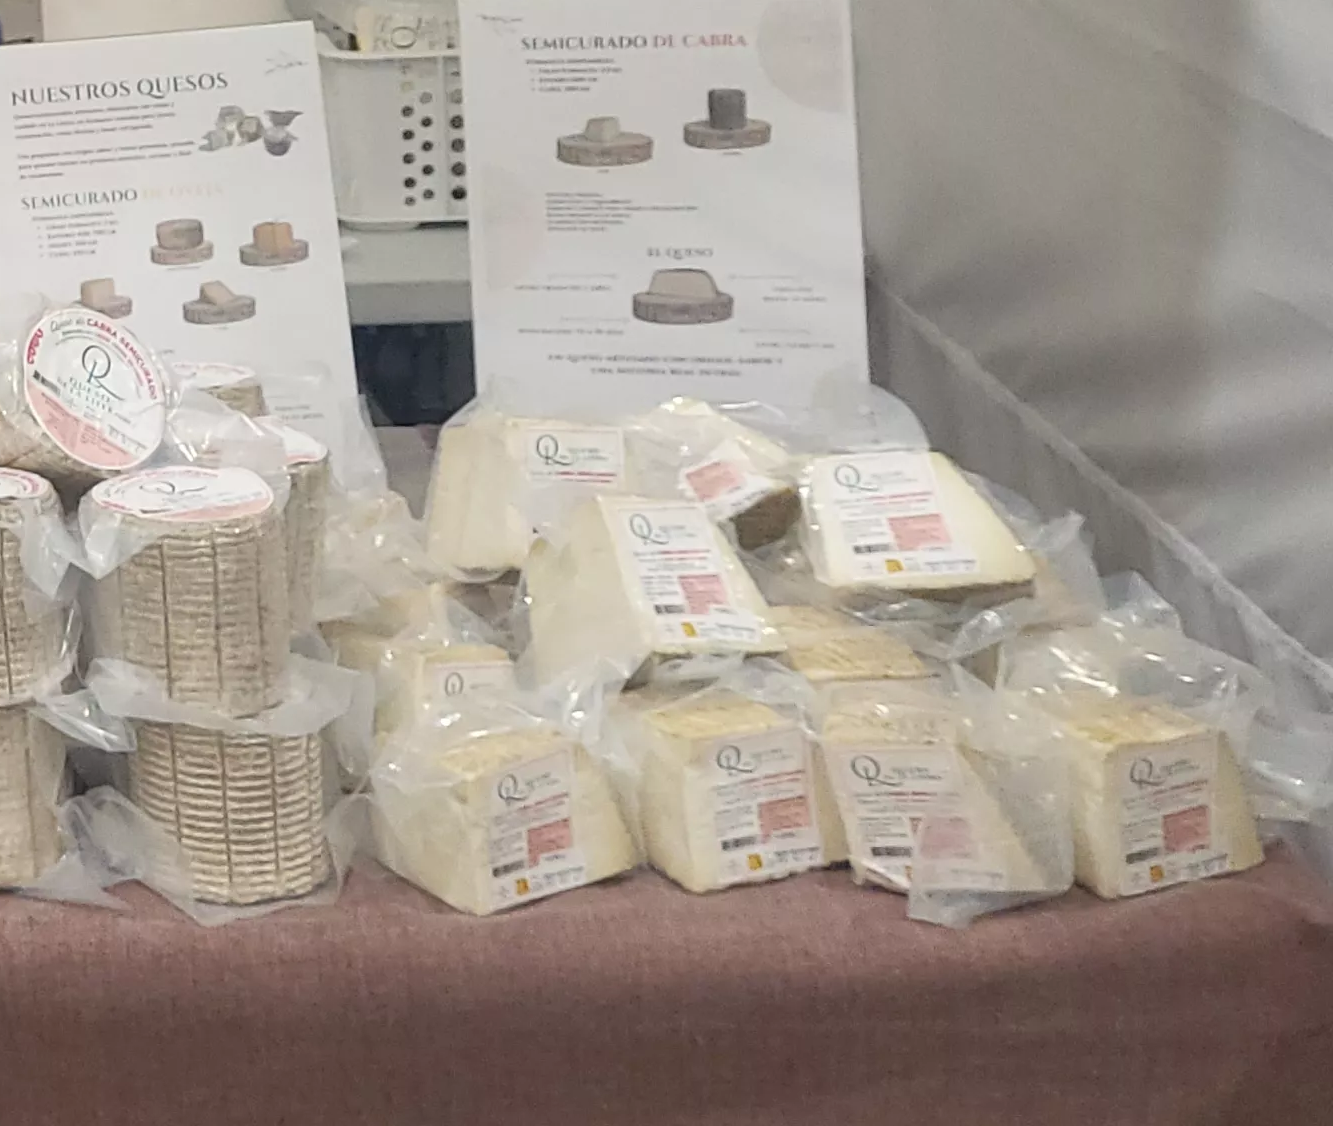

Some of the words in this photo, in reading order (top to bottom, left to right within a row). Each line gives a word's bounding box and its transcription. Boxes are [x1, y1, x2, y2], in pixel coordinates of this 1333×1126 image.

[521, 35, 648, 51] SEMICURADO
[653, 35, 674, 49] DE
[683, 33, 748, 48] CABRA
[11, 80, 131, 106] NUESTROS
[136, 72, 229, 99] QUESOS
[21, 188, 138, 211] SEMICURADO
